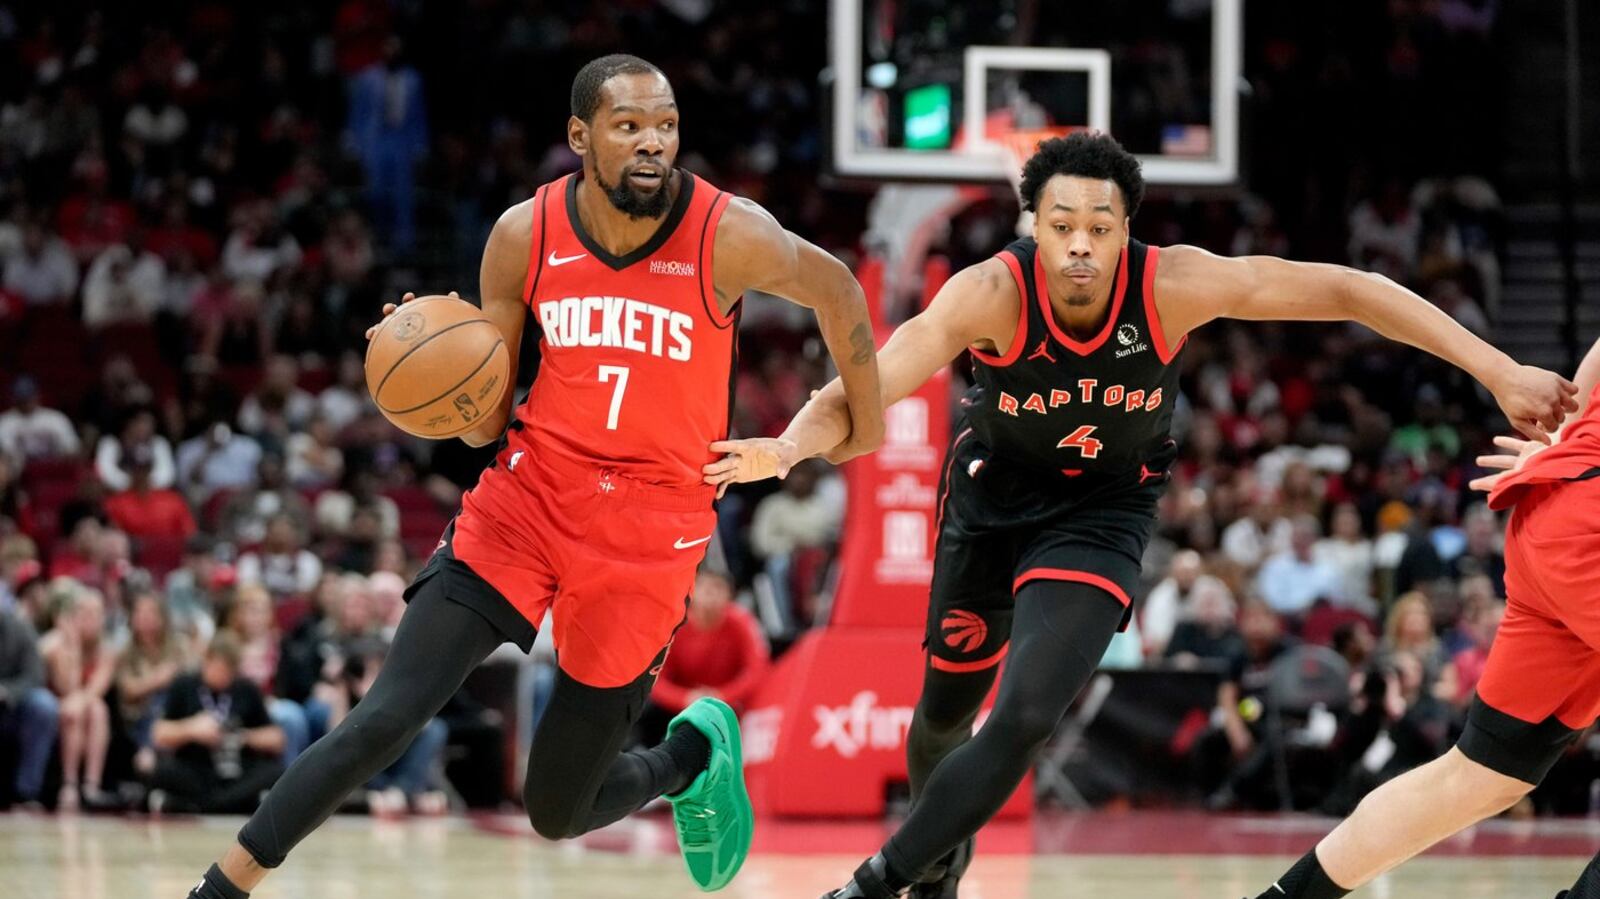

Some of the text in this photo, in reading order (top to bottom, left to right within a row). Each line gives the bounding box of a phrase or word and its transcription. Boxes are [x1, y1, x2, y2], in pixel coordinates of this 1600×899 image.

[650, 260, 694, 270] MEMORIAL
[650, 266, 694, 277] HERMANN
[538, 296, 694, 362] ROCKETS
[1115, 342, 1148, 359] Sun Life
[598, 364, 630, 431] 7
[998, 378, 1163, 417] RAPTORS
[1056, 424, 1103, 459] 4
[811, 689, 915, 758] xfin
